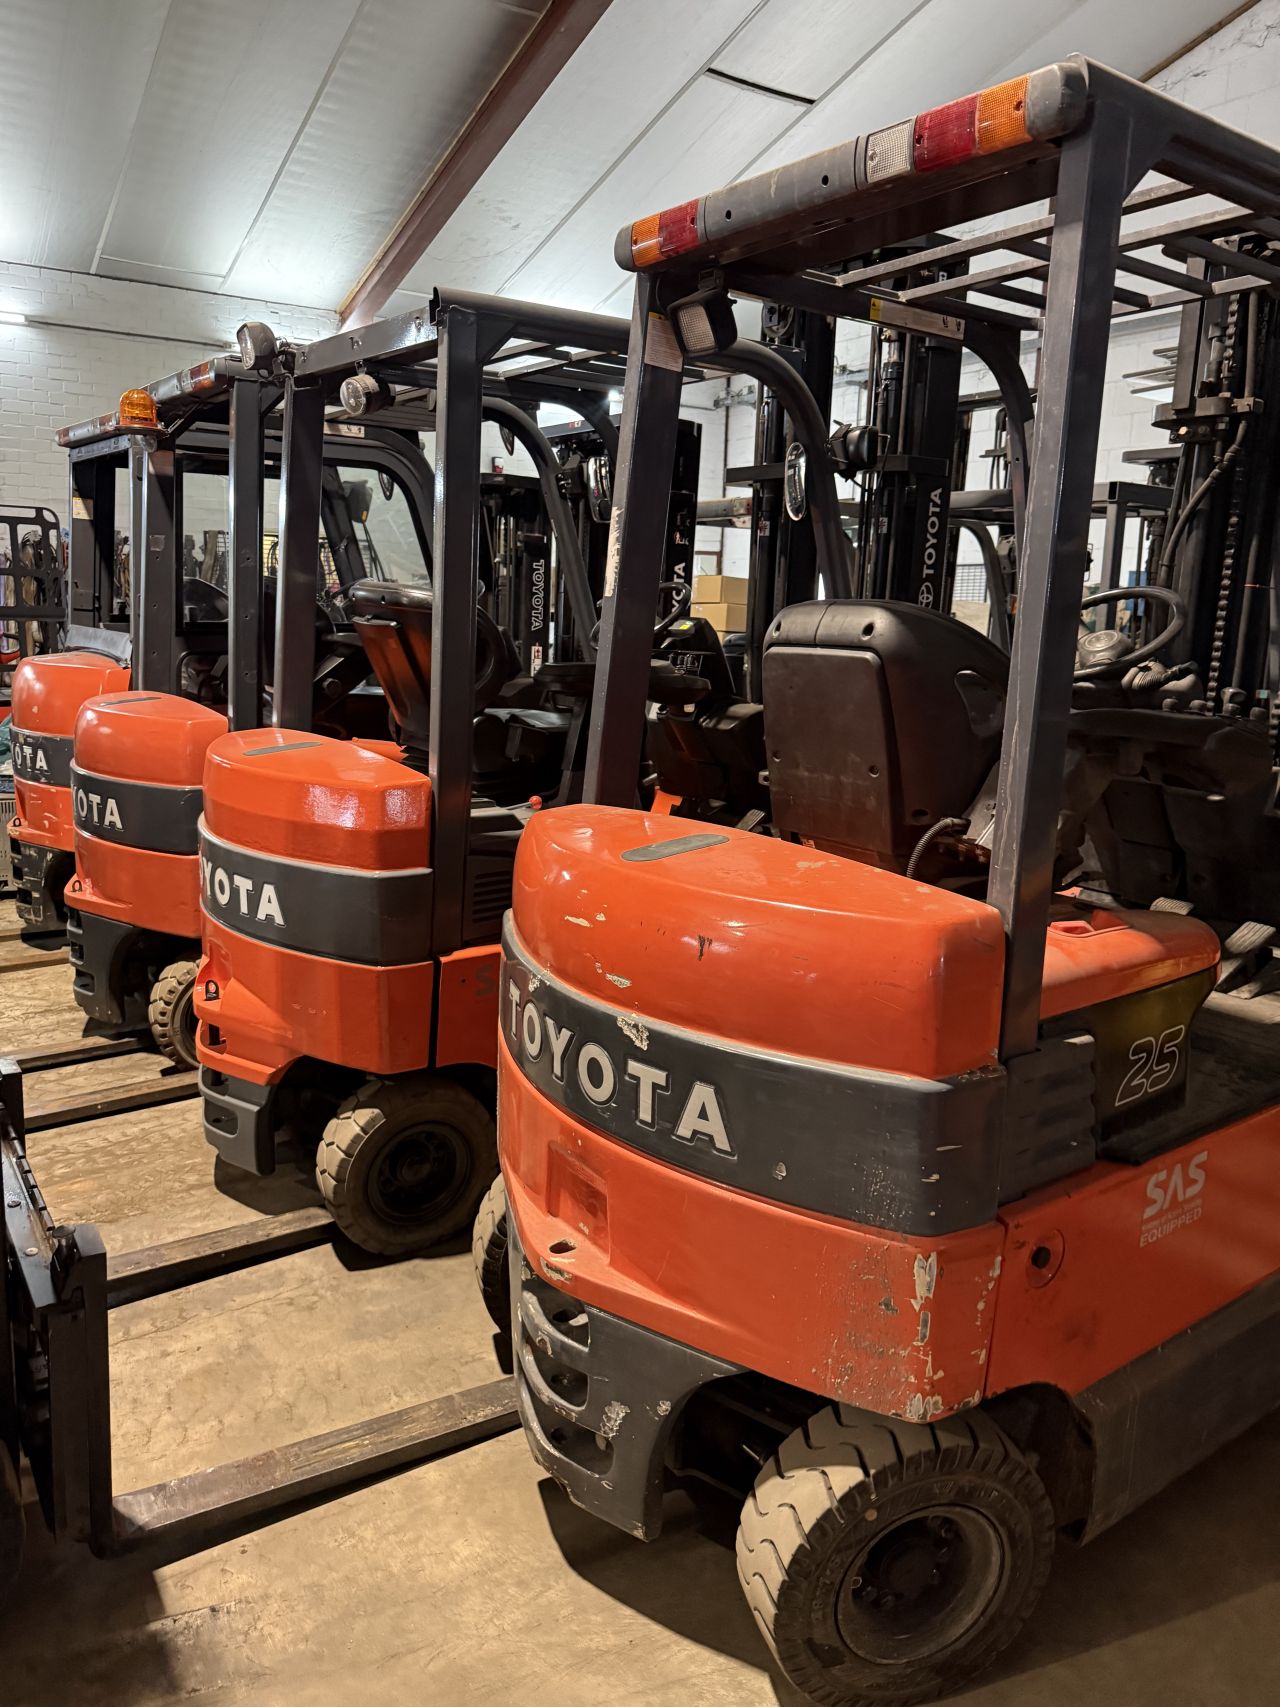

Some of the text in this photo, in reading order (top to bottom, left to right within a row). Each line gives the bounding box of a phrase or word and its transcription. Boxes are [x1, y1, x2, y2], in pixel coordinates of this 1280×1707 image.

[922, 488, 943, 579] TOYOTA
[531, 559, 545, 631] TOYOTA
[11, 742, 49, 772] OTA
[198, 853, 286, 927] YOTA
[508, 979, 736, 1158] TOYOTA
[1115, 1024, 1185, 1107] 25
[1143, 1151, 1208, 1220] SAS
[1139, 1207, 1202, 1248] EQUIPPED
